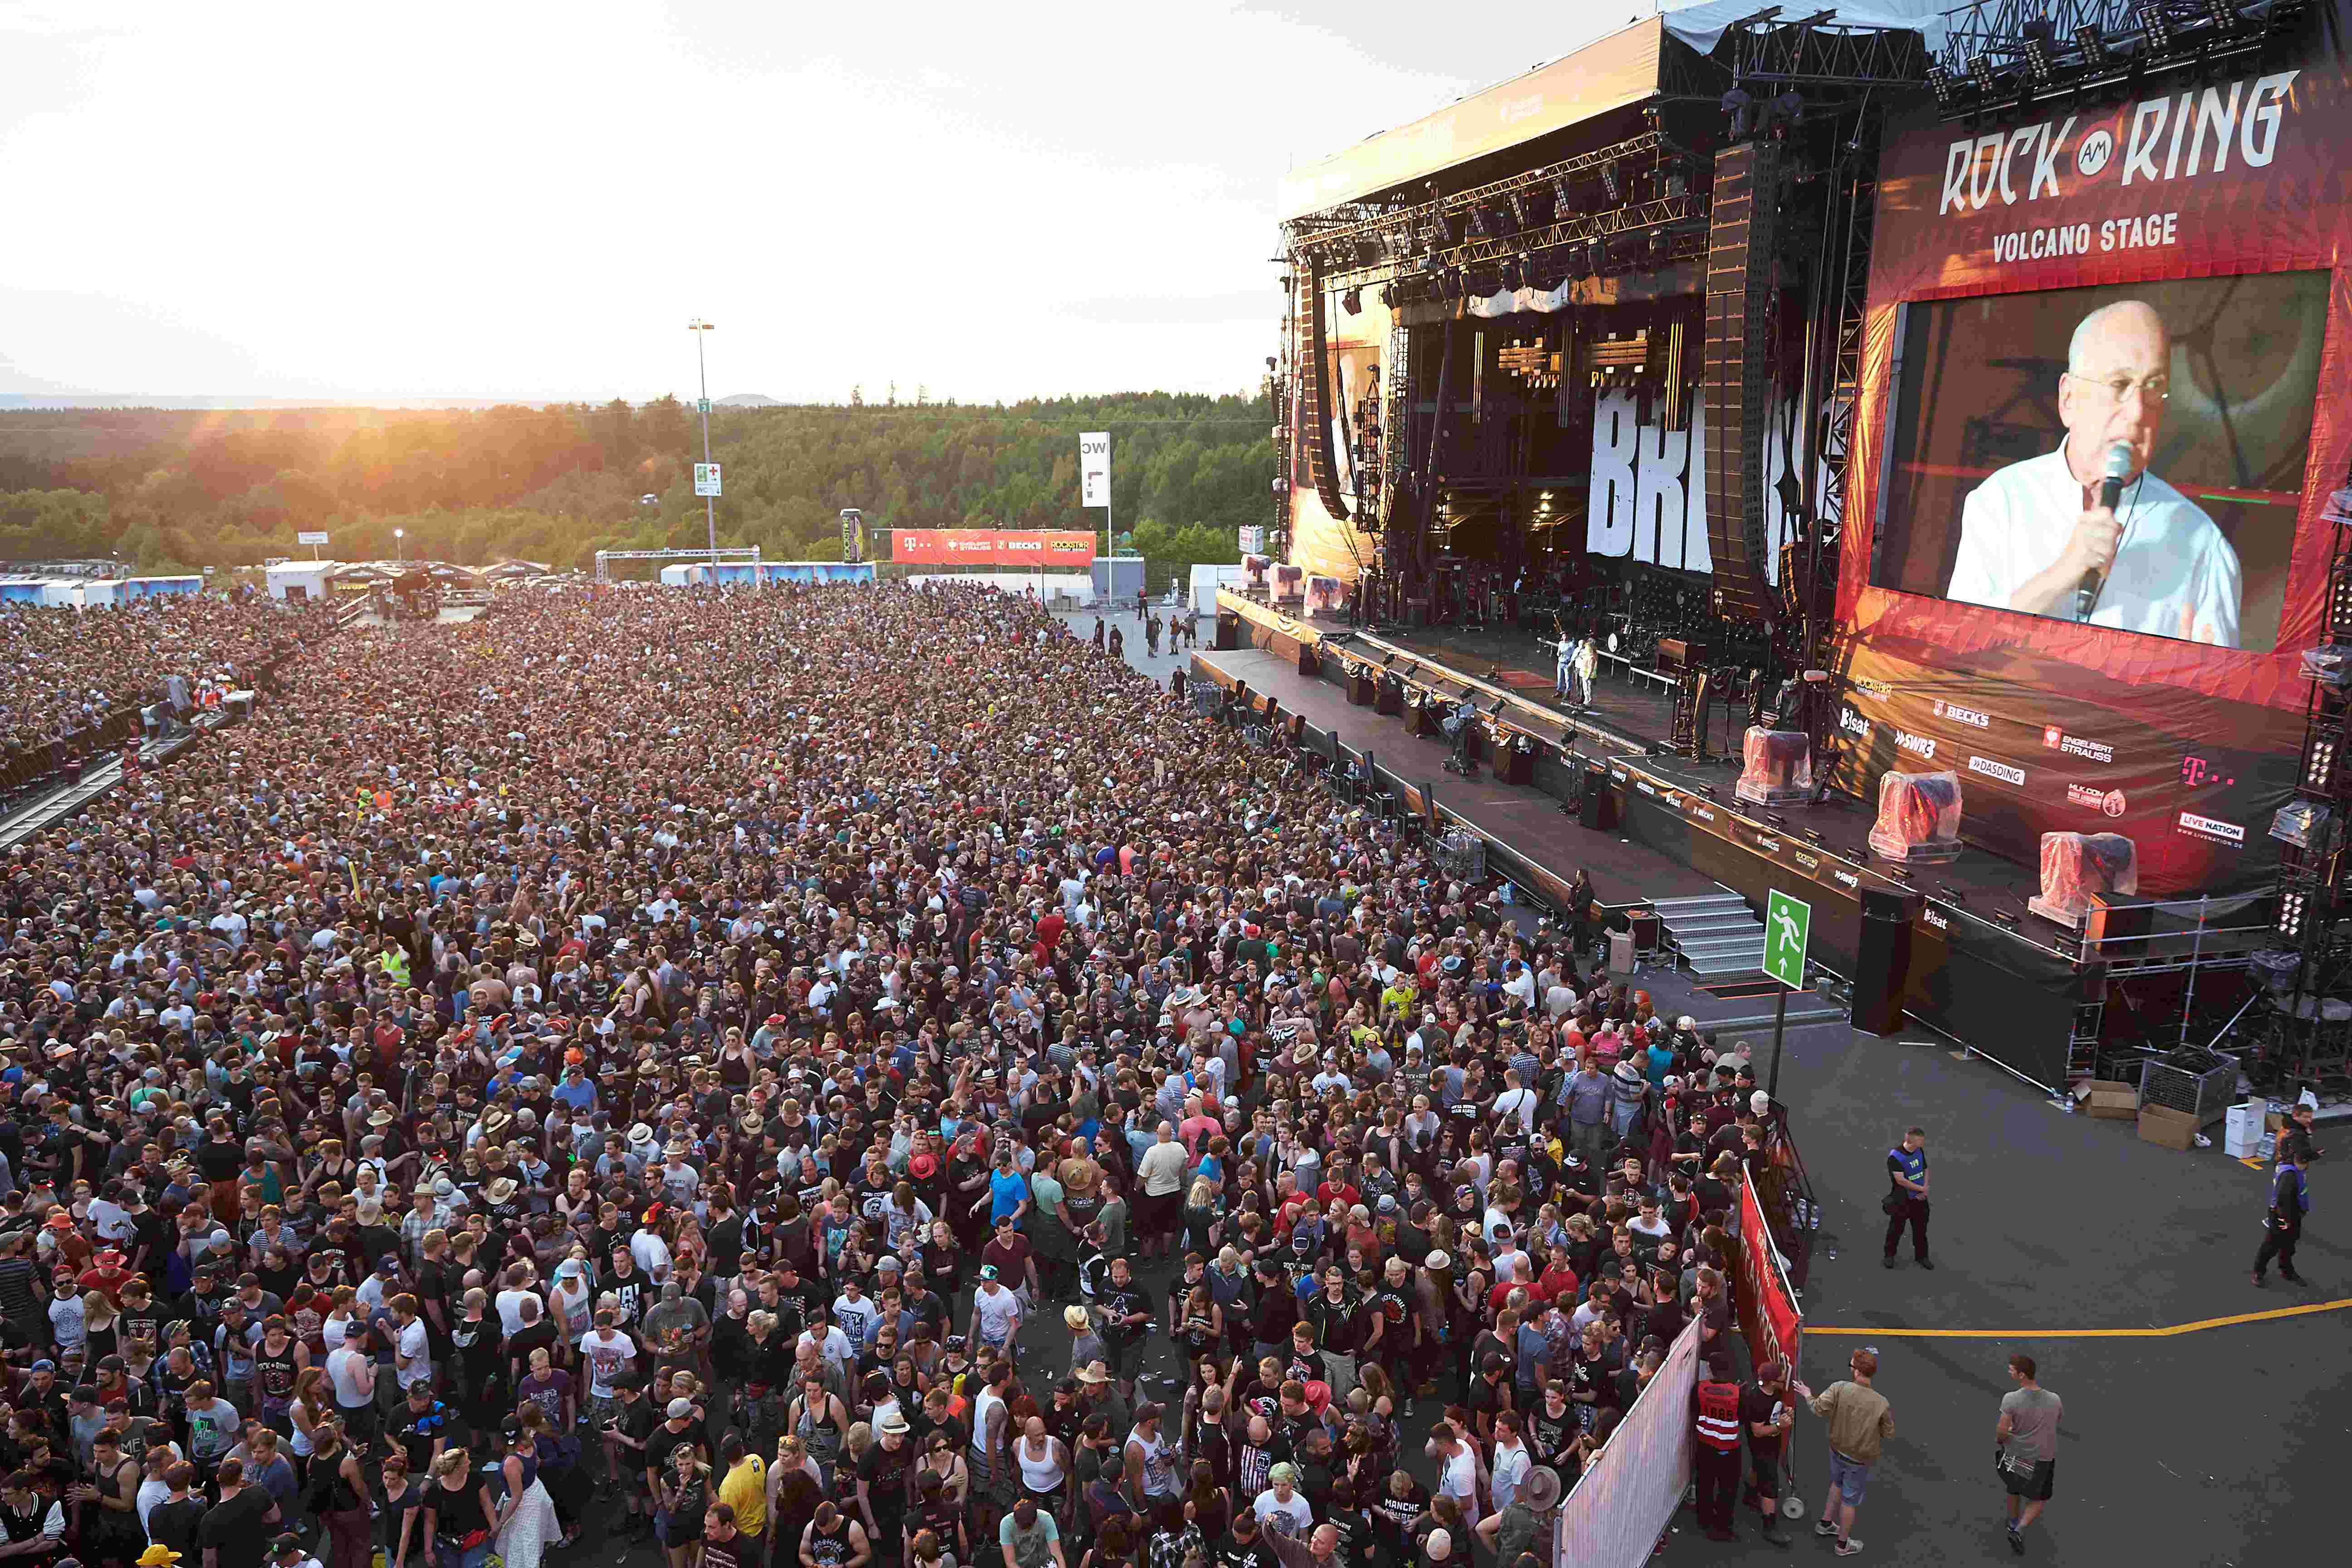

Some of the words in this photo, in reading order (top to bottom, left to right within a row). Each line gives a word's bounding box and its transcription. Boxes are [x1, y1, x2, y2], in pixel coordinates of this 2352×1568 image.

[1939, 116, 2078, 216] ROCK
[2080, 140, 2107, 164] AM
[2122, 69, 2301, 186] RING
[1993, 223, 2090, 263] VOLCANO
[2100, 212, 2178, 251] STAGE
[2060, 743, 2112, 763] STRAUSS
[2063, 735, 2113, 754] ENGELBERT
[2184, 816, 2204, 827] LIVE
[2205, 821, 2240, 836] NATION
[841, 1311, 862, 1323] ROCK
[1385, 1498, 1419, 1512] MANCHE
